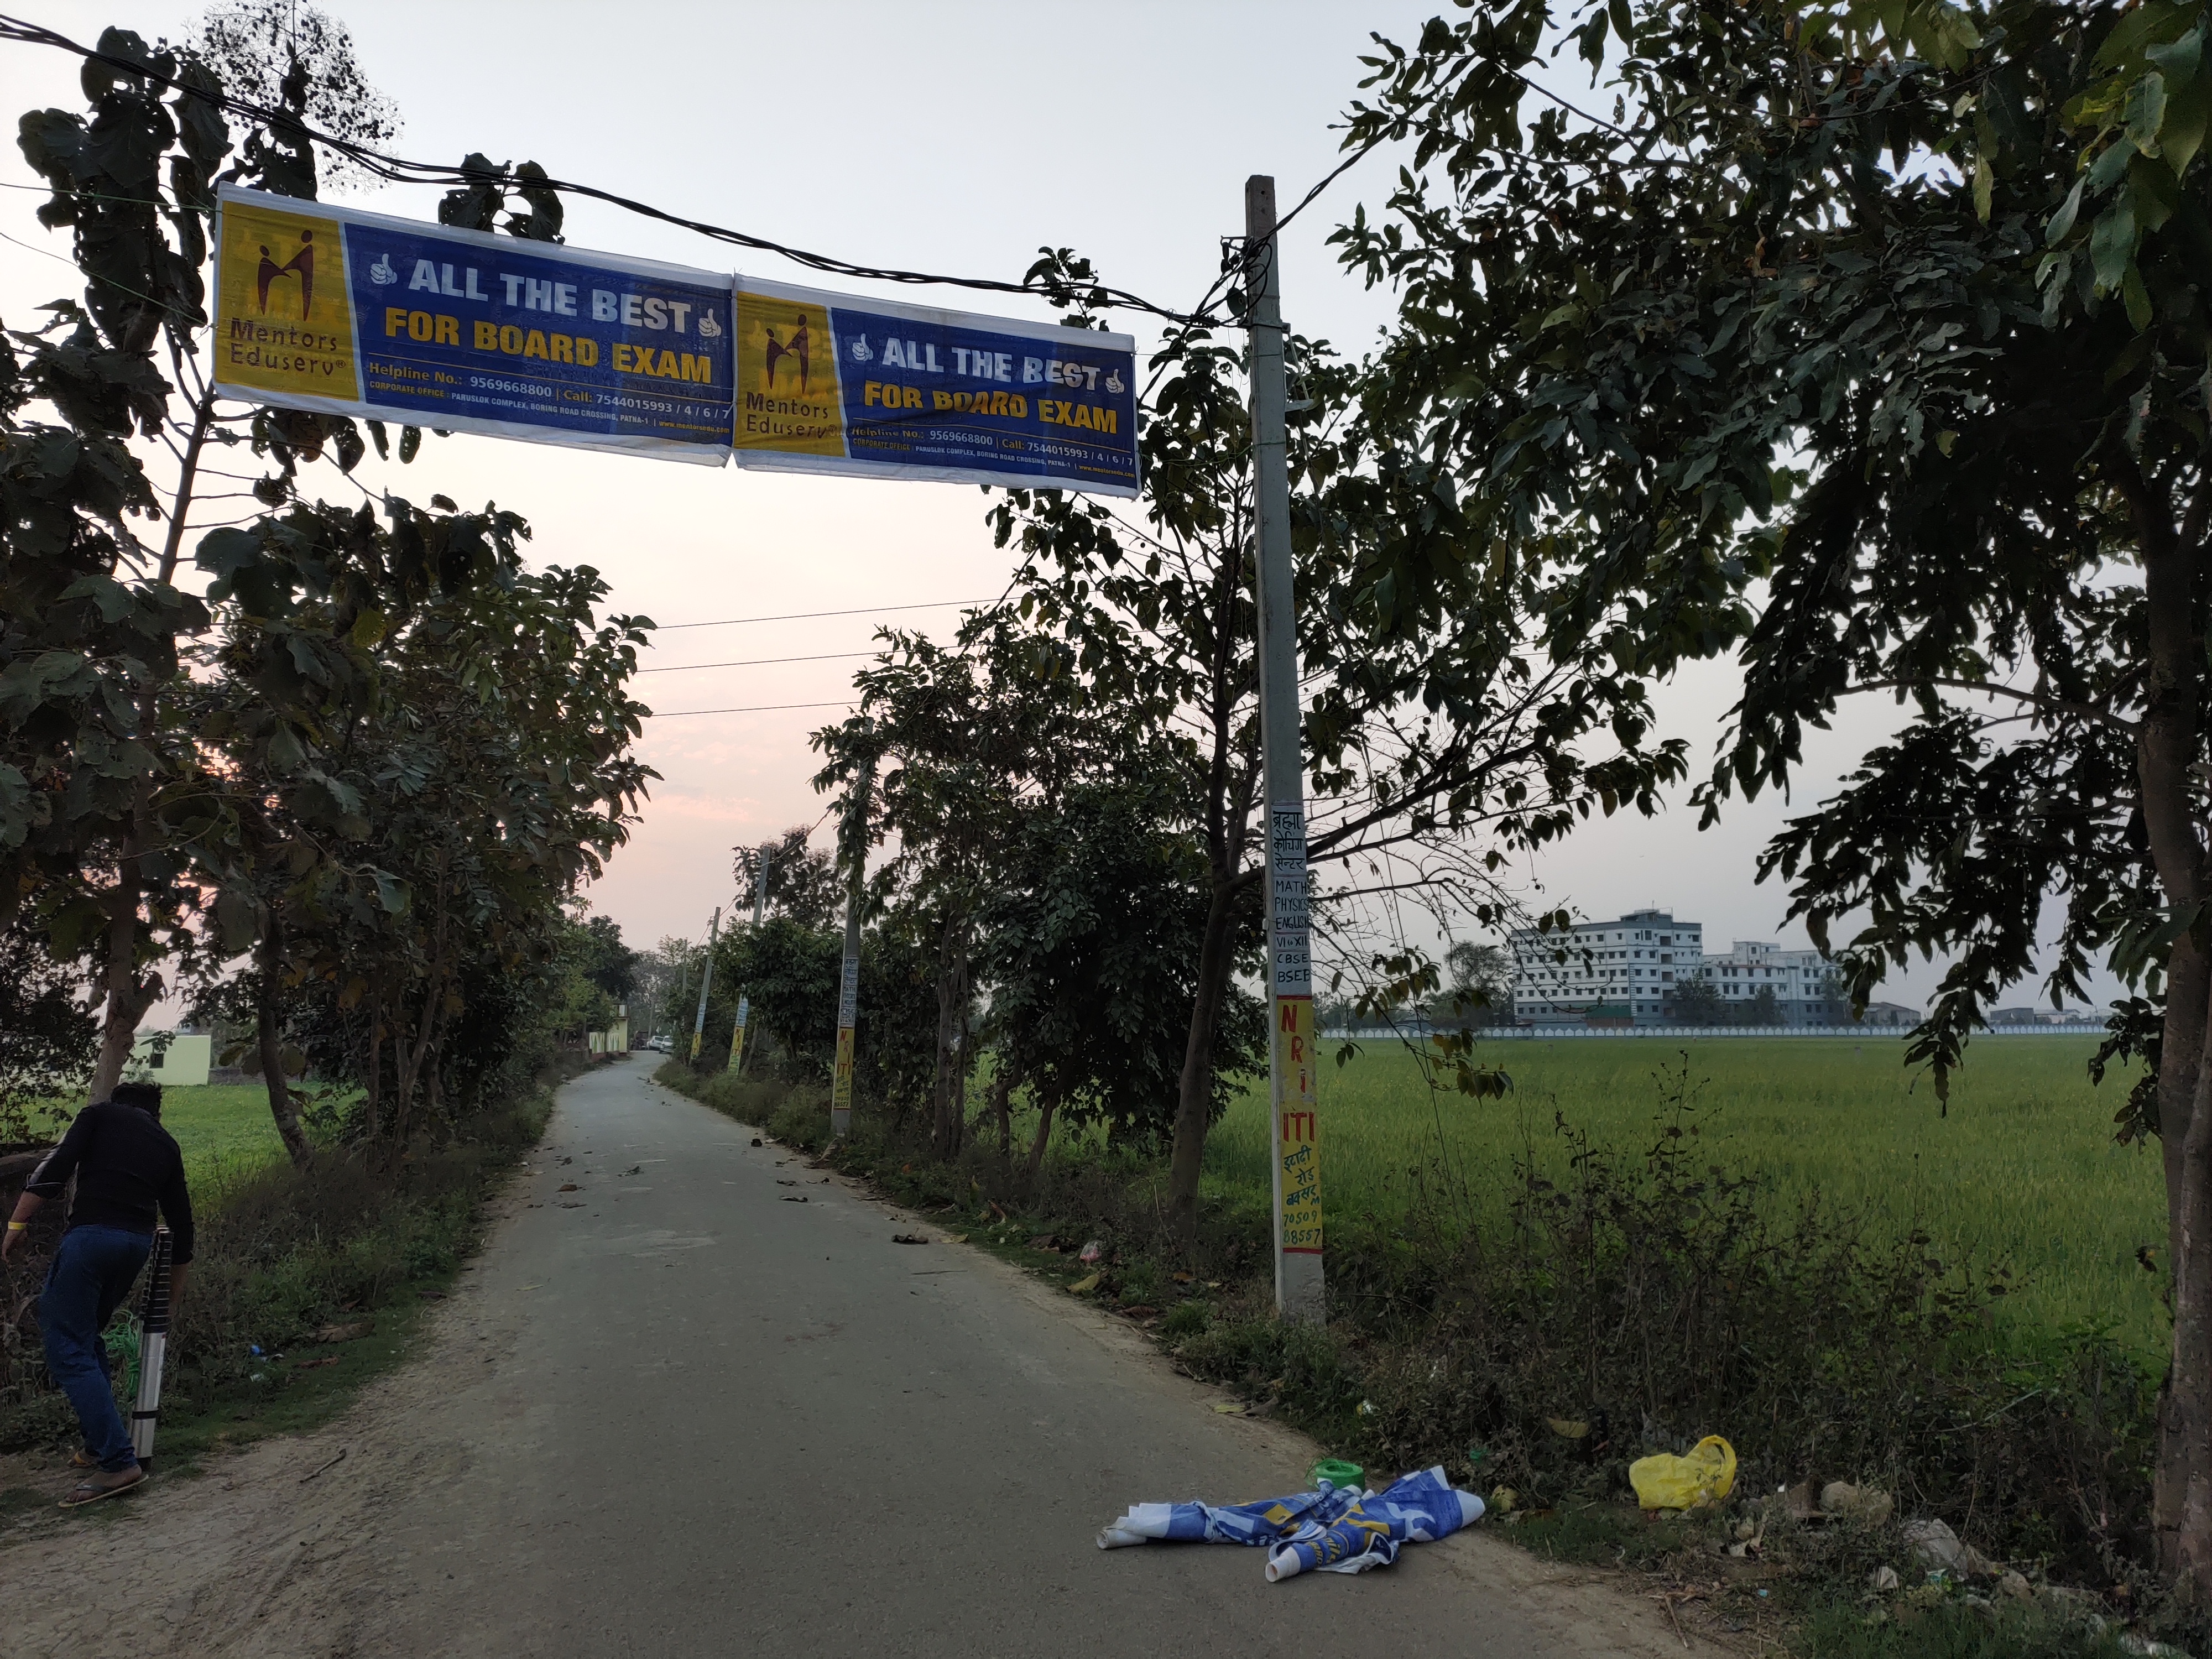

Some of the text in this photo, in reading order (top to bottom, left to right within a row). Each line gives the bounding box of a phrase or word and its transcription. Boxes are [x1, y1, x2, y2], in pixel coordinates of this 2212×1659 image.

[408, 259, 691, 333] ALL THE BEST
[231, 317, 337, 351] Mentors
[385, 307, 710, 384] FOR BOARD EXAM
[882, 337, 1100, 391] ALL THE BEST
[370, 362, 430, 381] Helpline
[435, 372, 462, 385] No.:
[470, 377, 551, 397] 9569668800
[564, 389, 592, 403] Call:
[596, 394, 672, 413] 7544015993
[370, 381, 415, 394] CORPORATE
[418, 388, 445, 398] OFFICE
[451, 393, 489, 404] PARUSLOK
[531, 403, 557, 413] BORING
[560, 407, 578, 416] ROAD
[620, 415, 648, 425] PATNA-1
[747, 392, 828, 419] Mentors
[865, 380, 1117, 434] FOR BOARD EXAM
[852, 427, 899, 437] Helpline
[930, 430, 993, 445] 9569668800
[1002, 439, 1024, 450] Call:
[1027, 442, 1088, 459] 7544015993
[853, 439, 888, 448] CORPORATE
[890, 442, 910, 451] OFFICE
[977, 451, 998, 460] BORING
[1273, 811, 1302, 830] ब्रह्मा
[1274, 830, 1303, 852] कोचिंग
[1276, 880, 1307, 894] MATH
[1275, 897, 1308, 912] PHYSICS
[1276, 916, 1309, 930] ENGLISH
[1277, 937, 1286, 947] VI
[1296, 935, 1307, 947] XII
[1277, 954, 1308, 963] CBSE
[1278, 969, 1311, 982] BSEB
[837, 1063, 851, 1075] ITI
[1284, 1112, 1314, 1142] ITI
[1295, 1166, 1314, 1186] रोड
[1284, 1210, 1317, 1227] 70509
[1284, 1229, 1321, 1244] 88557
